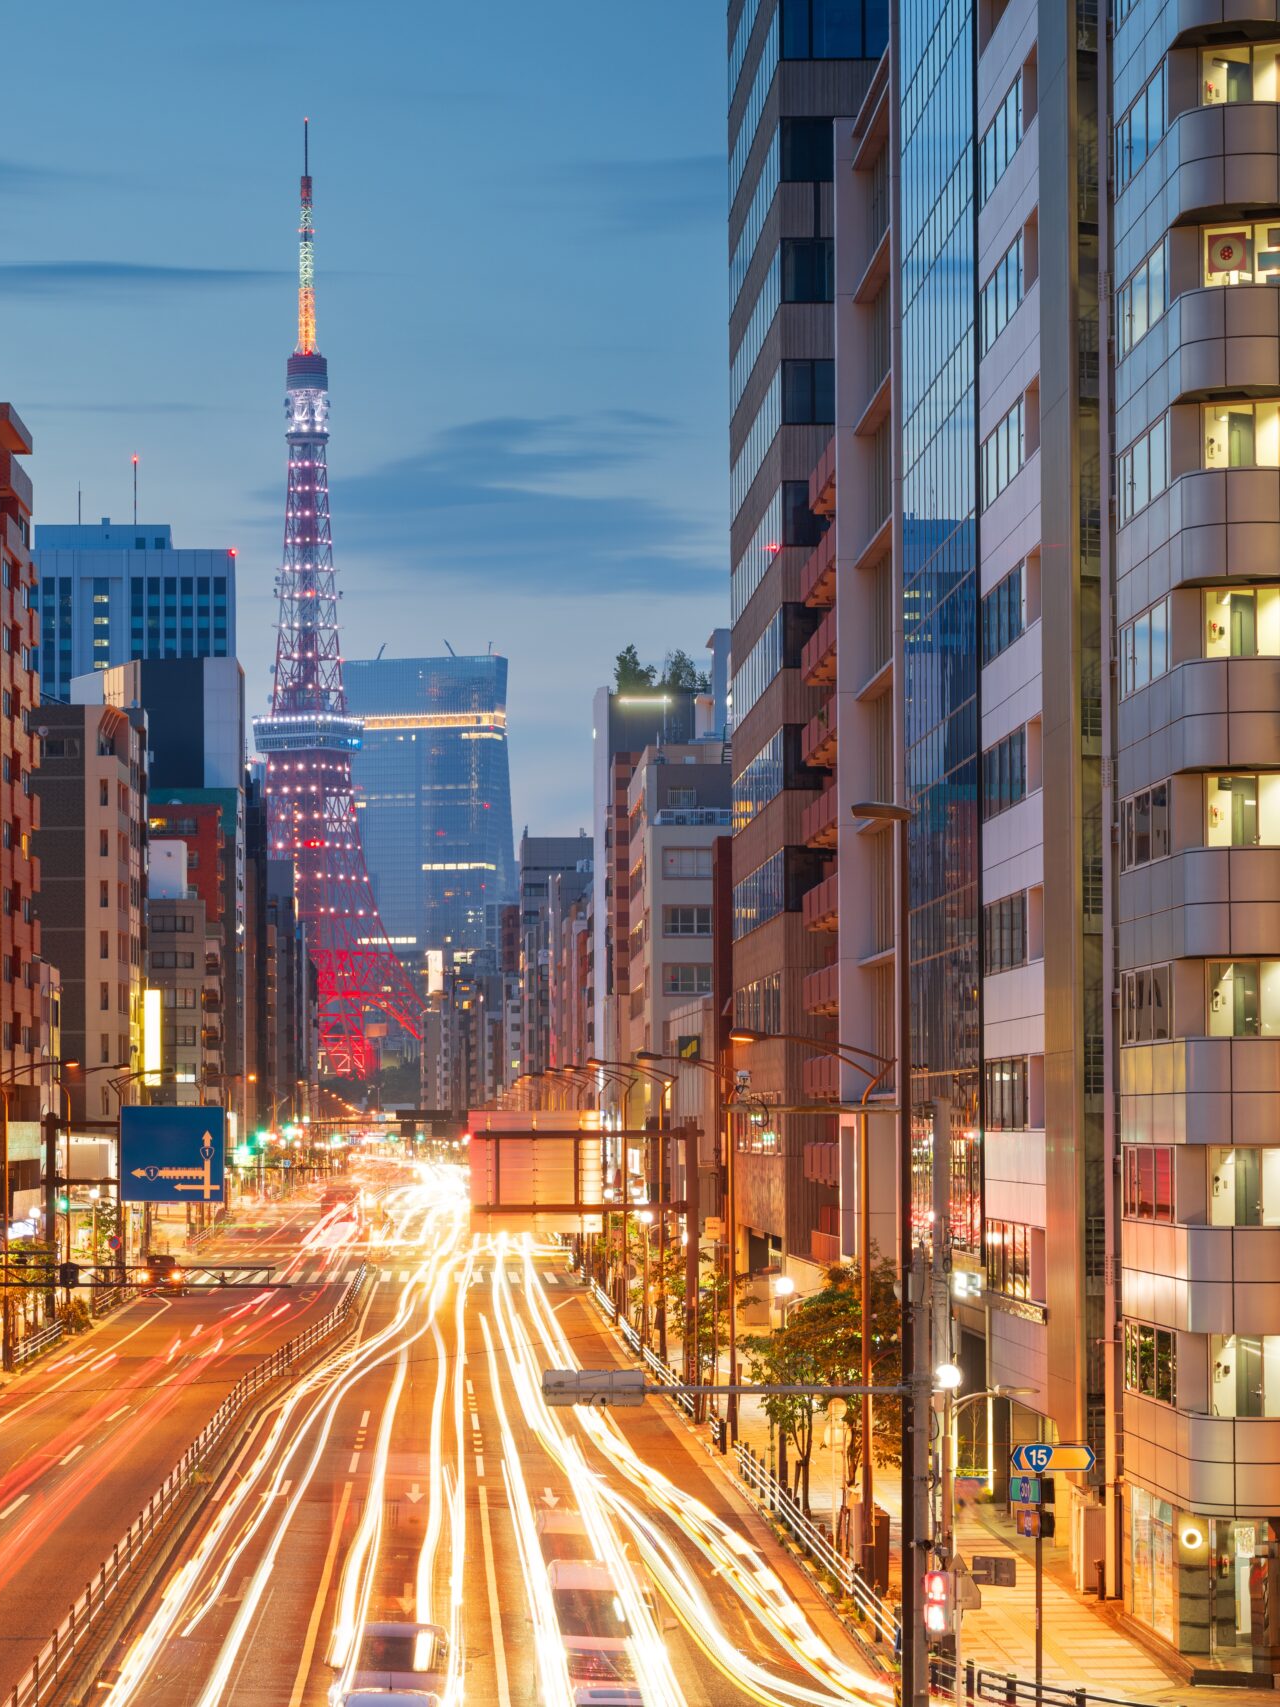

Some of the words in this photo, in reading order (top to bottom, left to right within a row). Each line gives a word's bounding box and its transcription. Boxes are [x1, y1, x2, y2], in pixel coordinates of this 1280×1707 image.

[149, 1168, 154, 1177] 1
[1029, 1449, 1047, 1466] 15
[1020, 1482, 1030, 1498] 301
